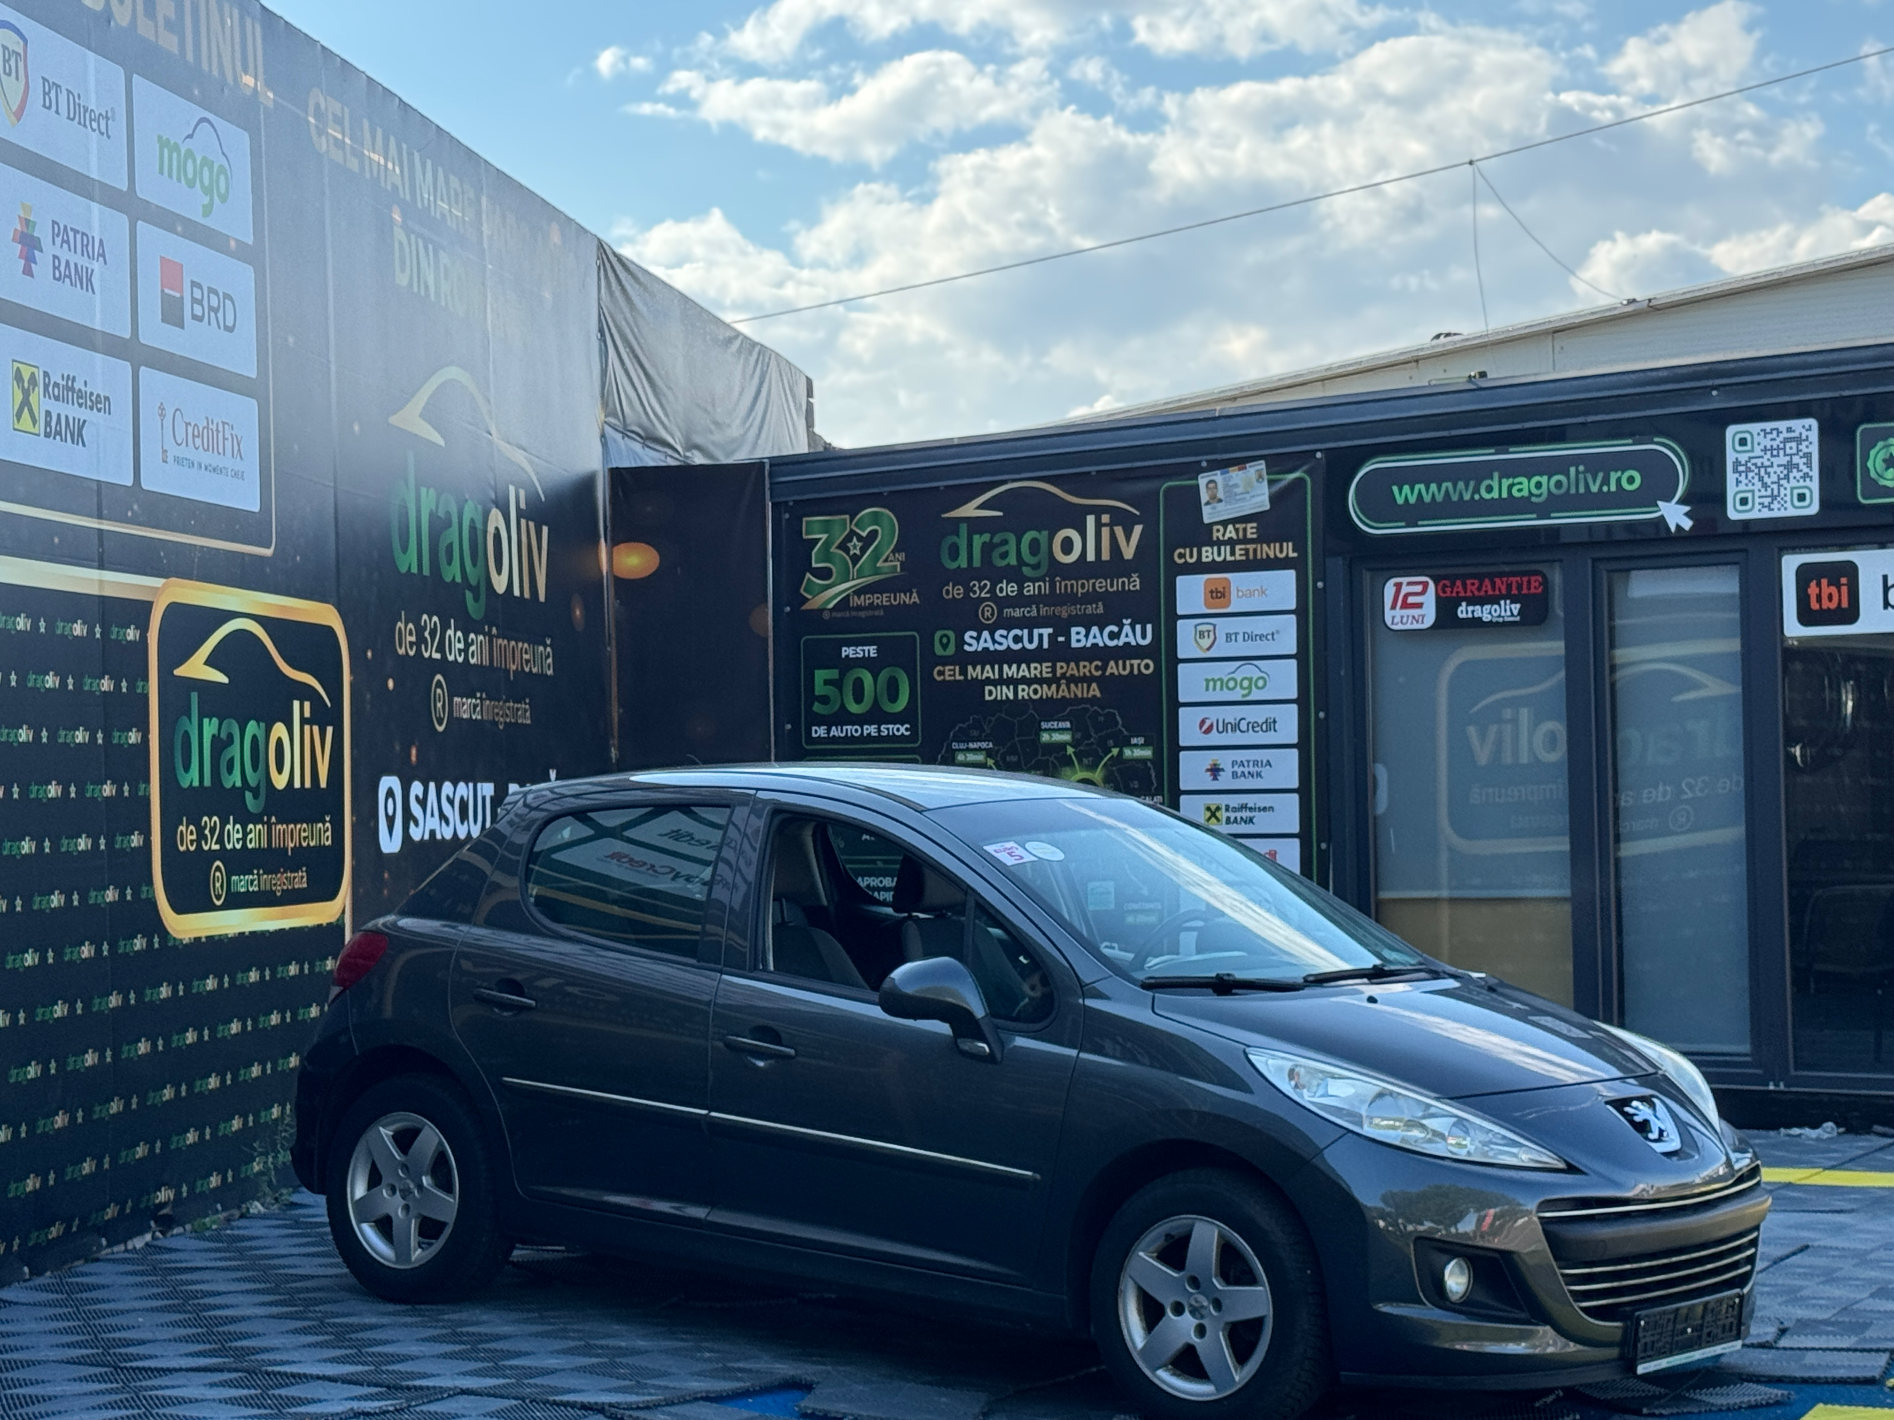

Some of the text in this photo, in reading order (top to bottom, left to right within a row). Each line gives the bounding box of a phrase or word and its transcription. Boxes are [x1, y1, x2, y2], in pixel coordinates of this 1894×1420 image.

[41, 75, 63, 115] BT
[308, 87, 359, 173] CEL
[363, 118, 410, 203] MAI
[157, 133, 230, 218] mogo
[51, 219, 107, 266] PATRIA
[52, 253, 96, 296] BANK
[392, 222, 435, 302] DIN
[190, 280, 237, 334] BRD
[43, 370, 112, 416] Raiffeisen
[44, 410, 88, 448] BANK
[172, 407, 244, 461] CreditFix
[1391, 465, 1642, 506] www.dragoliv.ro
[390, 450, 549, 620] dragoliv
[1212, 523, 1258, 541] RATE
[800, 507, 899, 600] 32
[940, 514, 1144, 578] dragoliv
[1173, 541, 1298, 565] CU BULETINUL
[942, 573, 1140, 600] de 32 de ani împreună
[1209, 586, 1268, 600] tbi bank
[1390, 580, 1429, 611] 12
[1437, 575, 1544, 597] GARANTIE
[1808, 578, 1850, 612] tbi
[1003, 604, 1037, 618] marcă
[1039, 602, 1104, 619] înregistrată
[1391, 614, 1426, 626] LUNI
[1457, 599, 1521, 622] dragoliv
[55, 619, 88, 640] dragoliv
[110, 625, 140, 644] dragoliv
[395, 610, 554, 680] de 32 de ani împreună
[963, 628, 1054, 652] SASCUT
[1070, 618, 1153, 648] BACĂU
[1198, 630, 1212, 640] BT
[1225, 632, 1240, 643] BT
[841, 646, 878, 659] PESTE
[26, 671, 60, 692] dragoliv
[82, 674, 115, 694] dragoliv
[933, 659, 1154, 682] CEL MAI MARE PARC AUTO
[812, 667, 910, 715] 500
[984, 680, 1101, 701] DIN ROMÂNIA
[1204, 676, 1268, 699] mogo
[453, 693, 482, 720] marcă
[57, 726, 90, 747] dragoliv
[112, 728, 142, 747] dragoliv
[812, 724, 911, 738] DE AUTO PE STOC
[1216, 717, 1278, 734] UniCredit
[173, 691, 334, 814] dragoliv
[1231, 759, 1273, 769] PATRIA
[1231, 770, 1264, 780] BANK
[28, 780, 62, 802] dragoliv
[85, 780, 117, 801] dragoliv
[409, 779, 495, 842] SASCUT
[1224, 803, 1275, 813] Raiffeisen
[1225, 815, 1256, 826] BANK
[2, 831, 144, 859] dragoliv dragoliv dragoliv
[177, 814, 332, 856] de 32 de ani împreună
[231, 869, 259, 893] marcă
[259, 866, 308, 897] înregistrată
[32, 890, 65, 912] dragoliv
[88, 885, 120, 907] dragoliv
[5, 948, 40, 971] dragoliv
[63, 941, 96, 963] dragoliv
[118, 934, 147, 956] dragoliv
